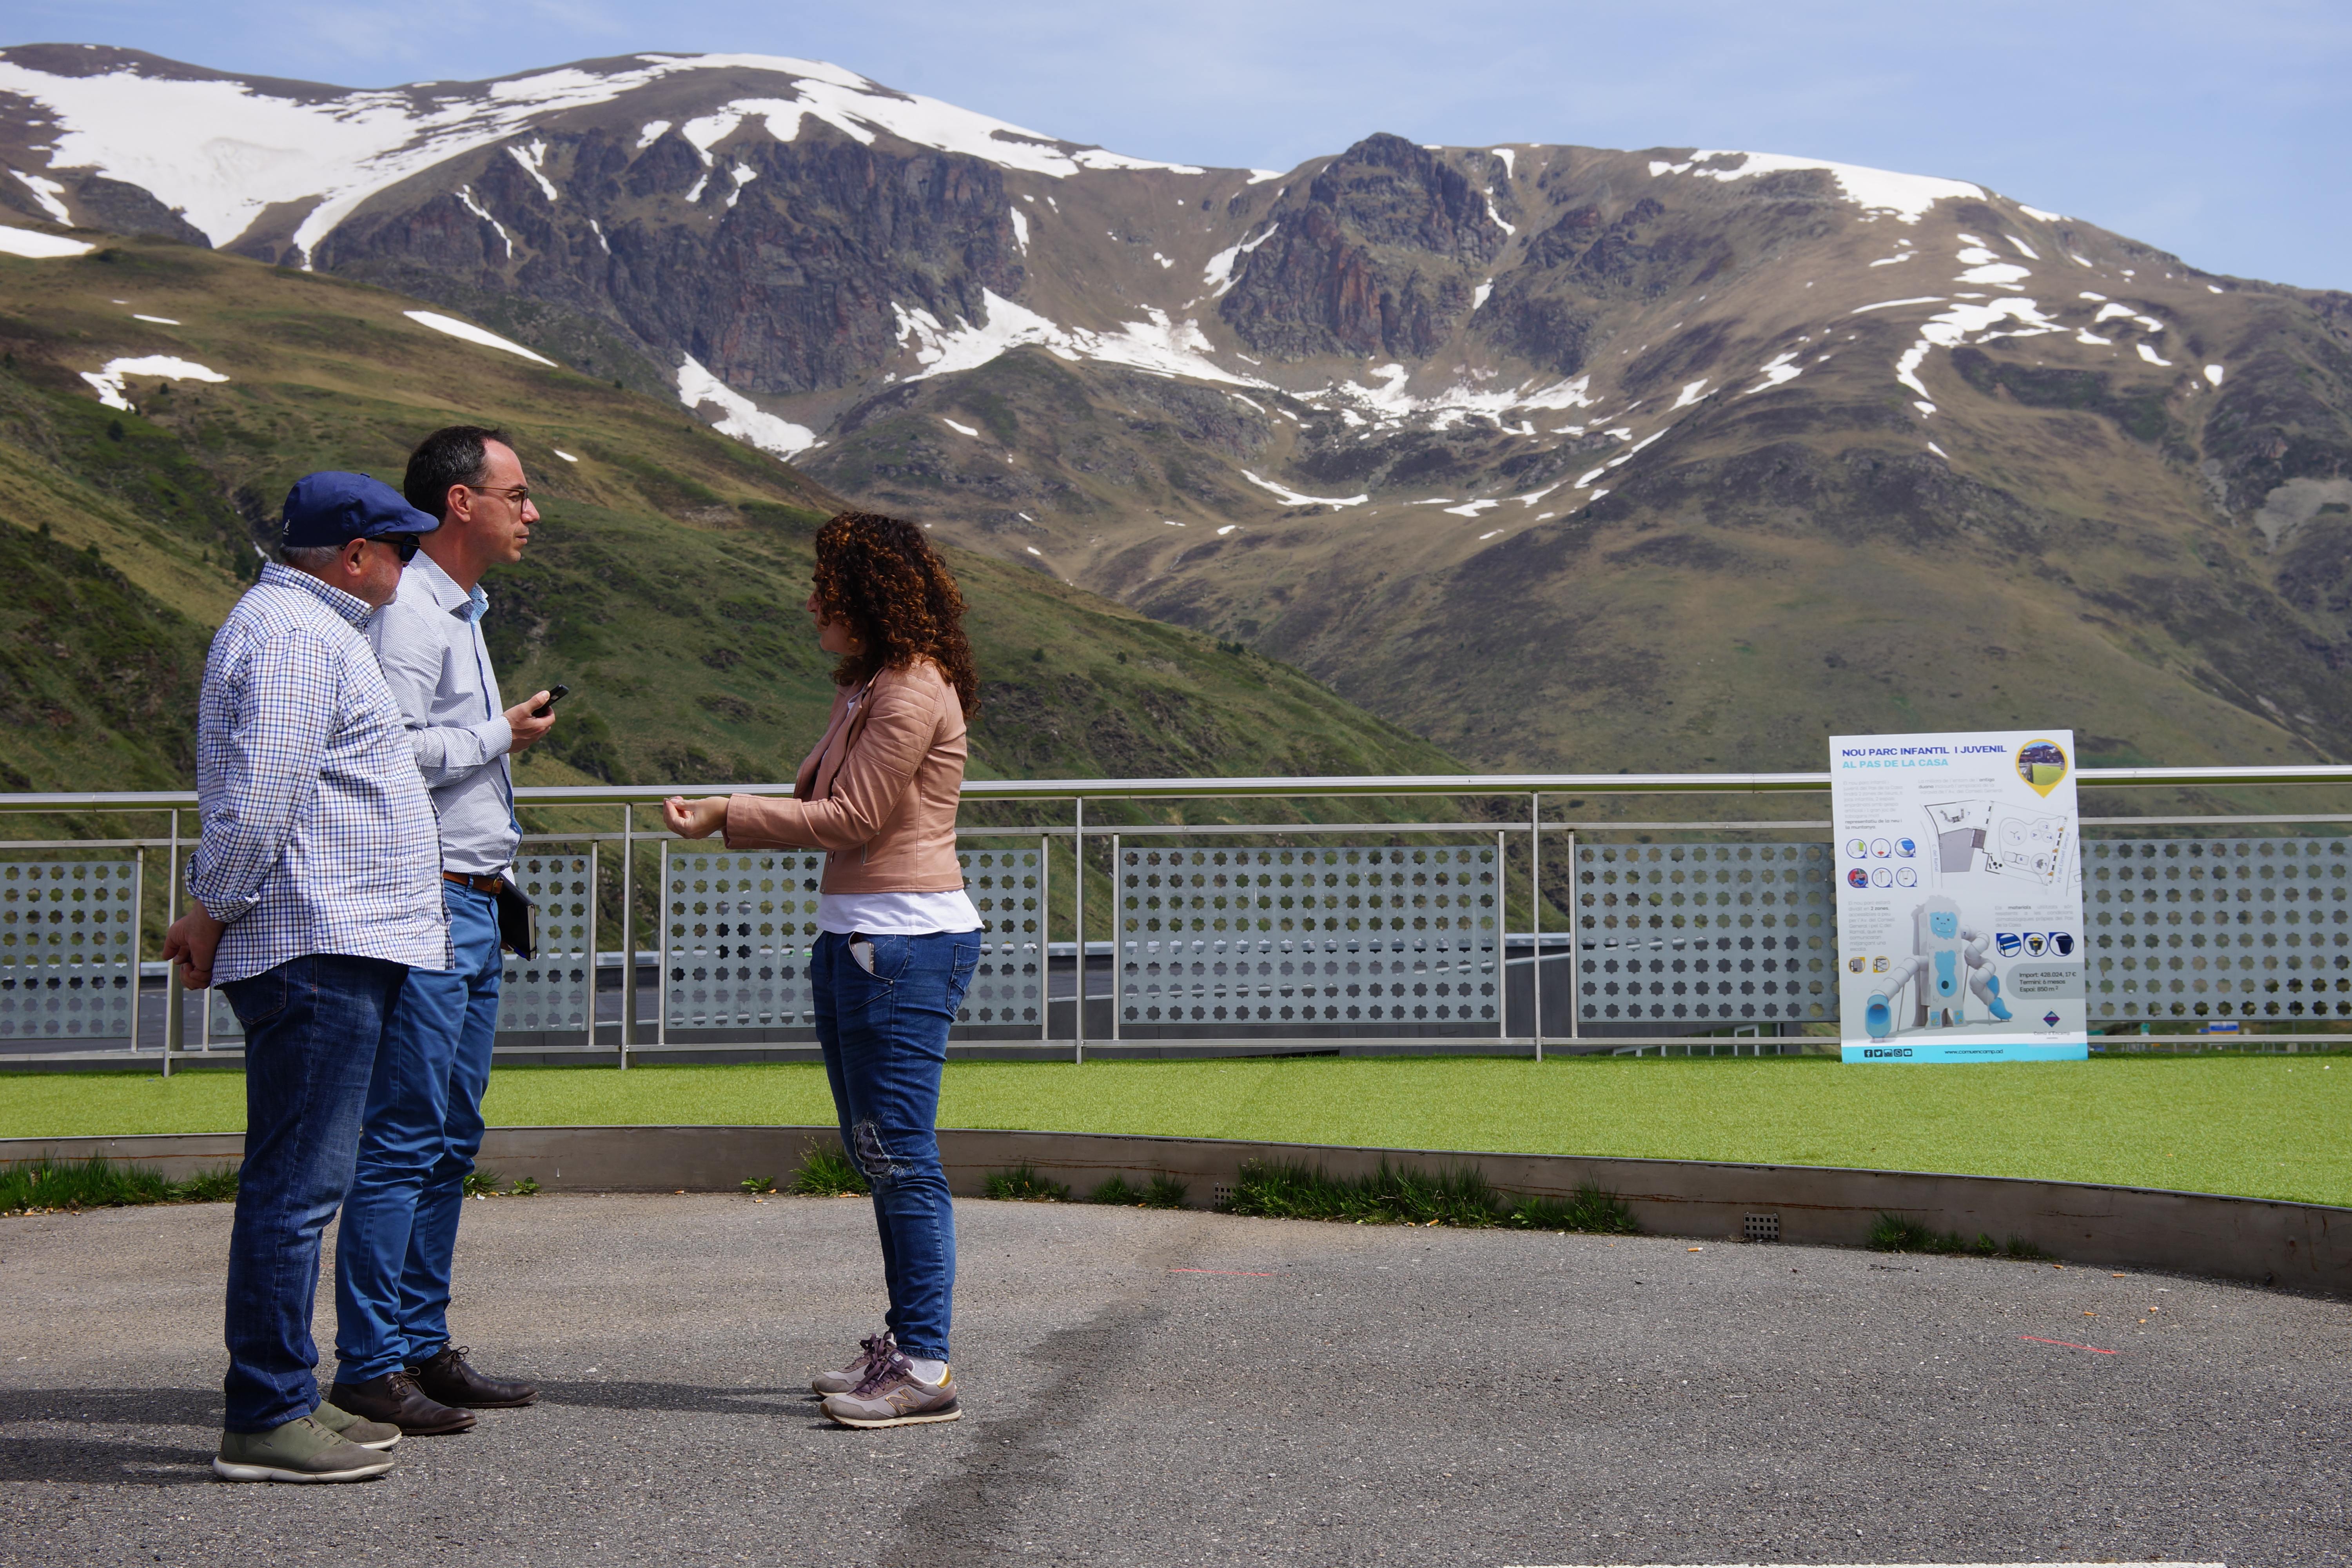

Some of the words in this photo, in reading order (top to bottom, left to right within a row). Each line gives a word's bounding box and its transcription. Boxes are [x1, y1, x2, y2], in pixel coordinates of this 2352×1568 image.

[1842, 749, 1866, 757] NOU
[1869, 748, 1898, 756] PARC
[1901, 746, 1950, 755] INFANTIL
[1960, 745, 2007, 754] JUVENIL
[1859, 760, 1881, 768] PAS
[1884, 759, 1899, 768] DE
[1902, 759, 1916, 767] LA
[1918, 758, 1949, 766] CASA
